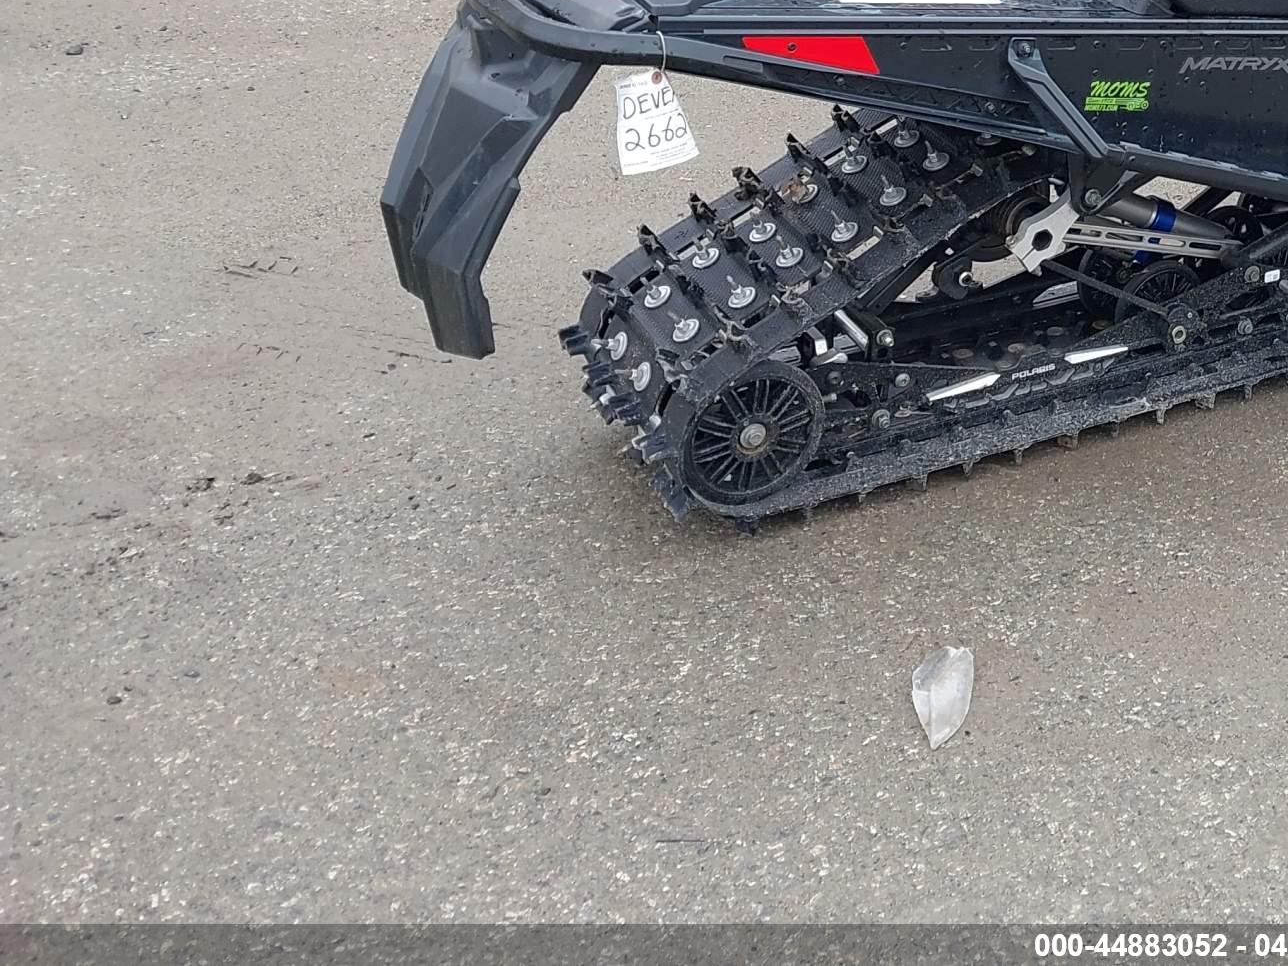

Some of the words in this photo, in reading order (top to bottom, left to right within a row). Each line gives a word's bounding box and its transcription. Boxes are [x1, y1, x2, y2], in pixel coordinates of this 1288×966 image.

[1090, 80, 1151, 98] MOMS
[623, 86, 675, 120] DEVE
[1011, 362, 1057, 381] POLARIS
